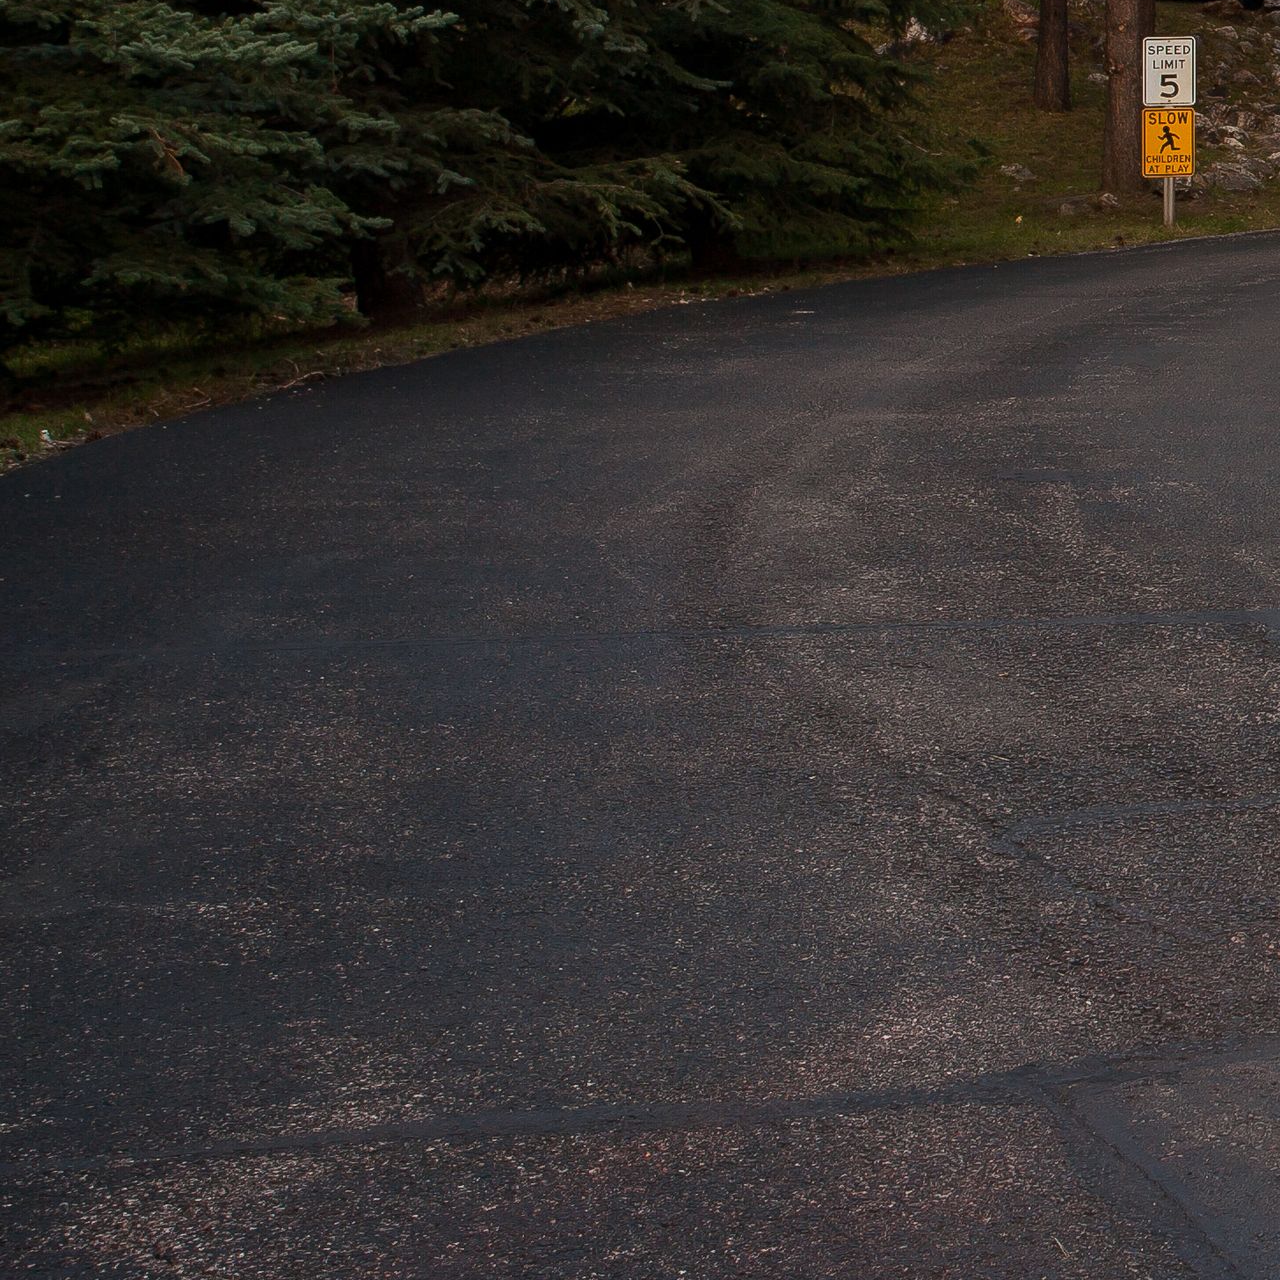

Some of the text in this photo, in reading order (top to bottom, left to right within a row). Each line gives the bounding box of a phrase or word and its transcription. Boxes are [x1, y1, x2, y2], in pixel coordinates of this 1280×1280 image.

[1147, 45, 1191, 55] SPEED
[1152, 60, 1186, 70] LIMIT
[1160, 74, 1179, 98] 5
[1148, 113, 1188, 125] SLOW
[1146, 154, 1191, 164] CHILDREN
[1148, 165, 1190, 174] AT PLAY
